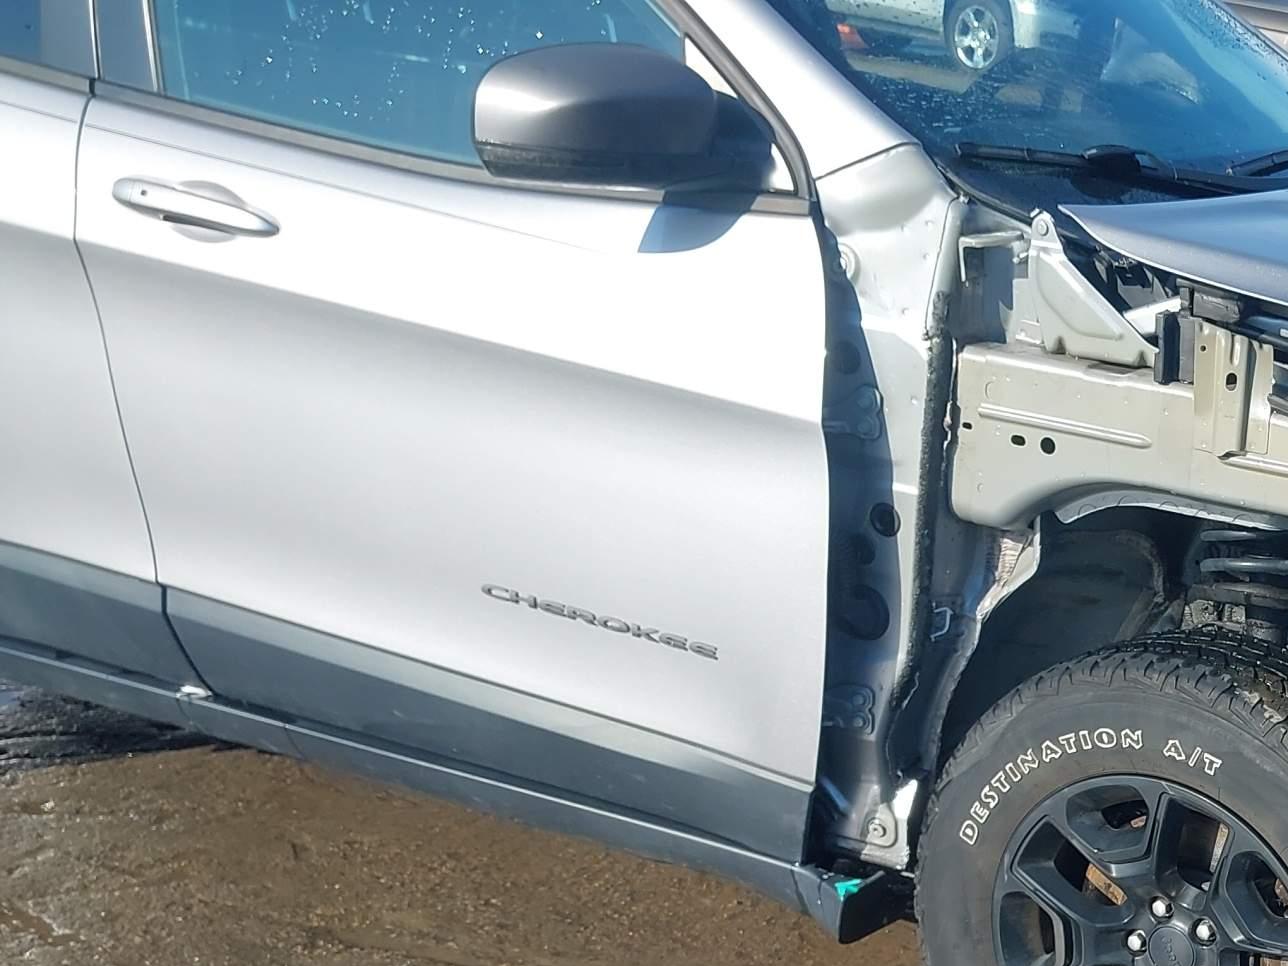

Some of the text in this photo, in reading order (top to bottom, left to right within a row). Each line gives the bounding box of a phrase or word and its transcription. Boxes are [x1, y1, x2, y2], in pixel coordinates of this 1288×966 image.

[481, 583, 719, 660] CHEROKEE
[959, 728, 1223, 845] DESTINATION A/T
